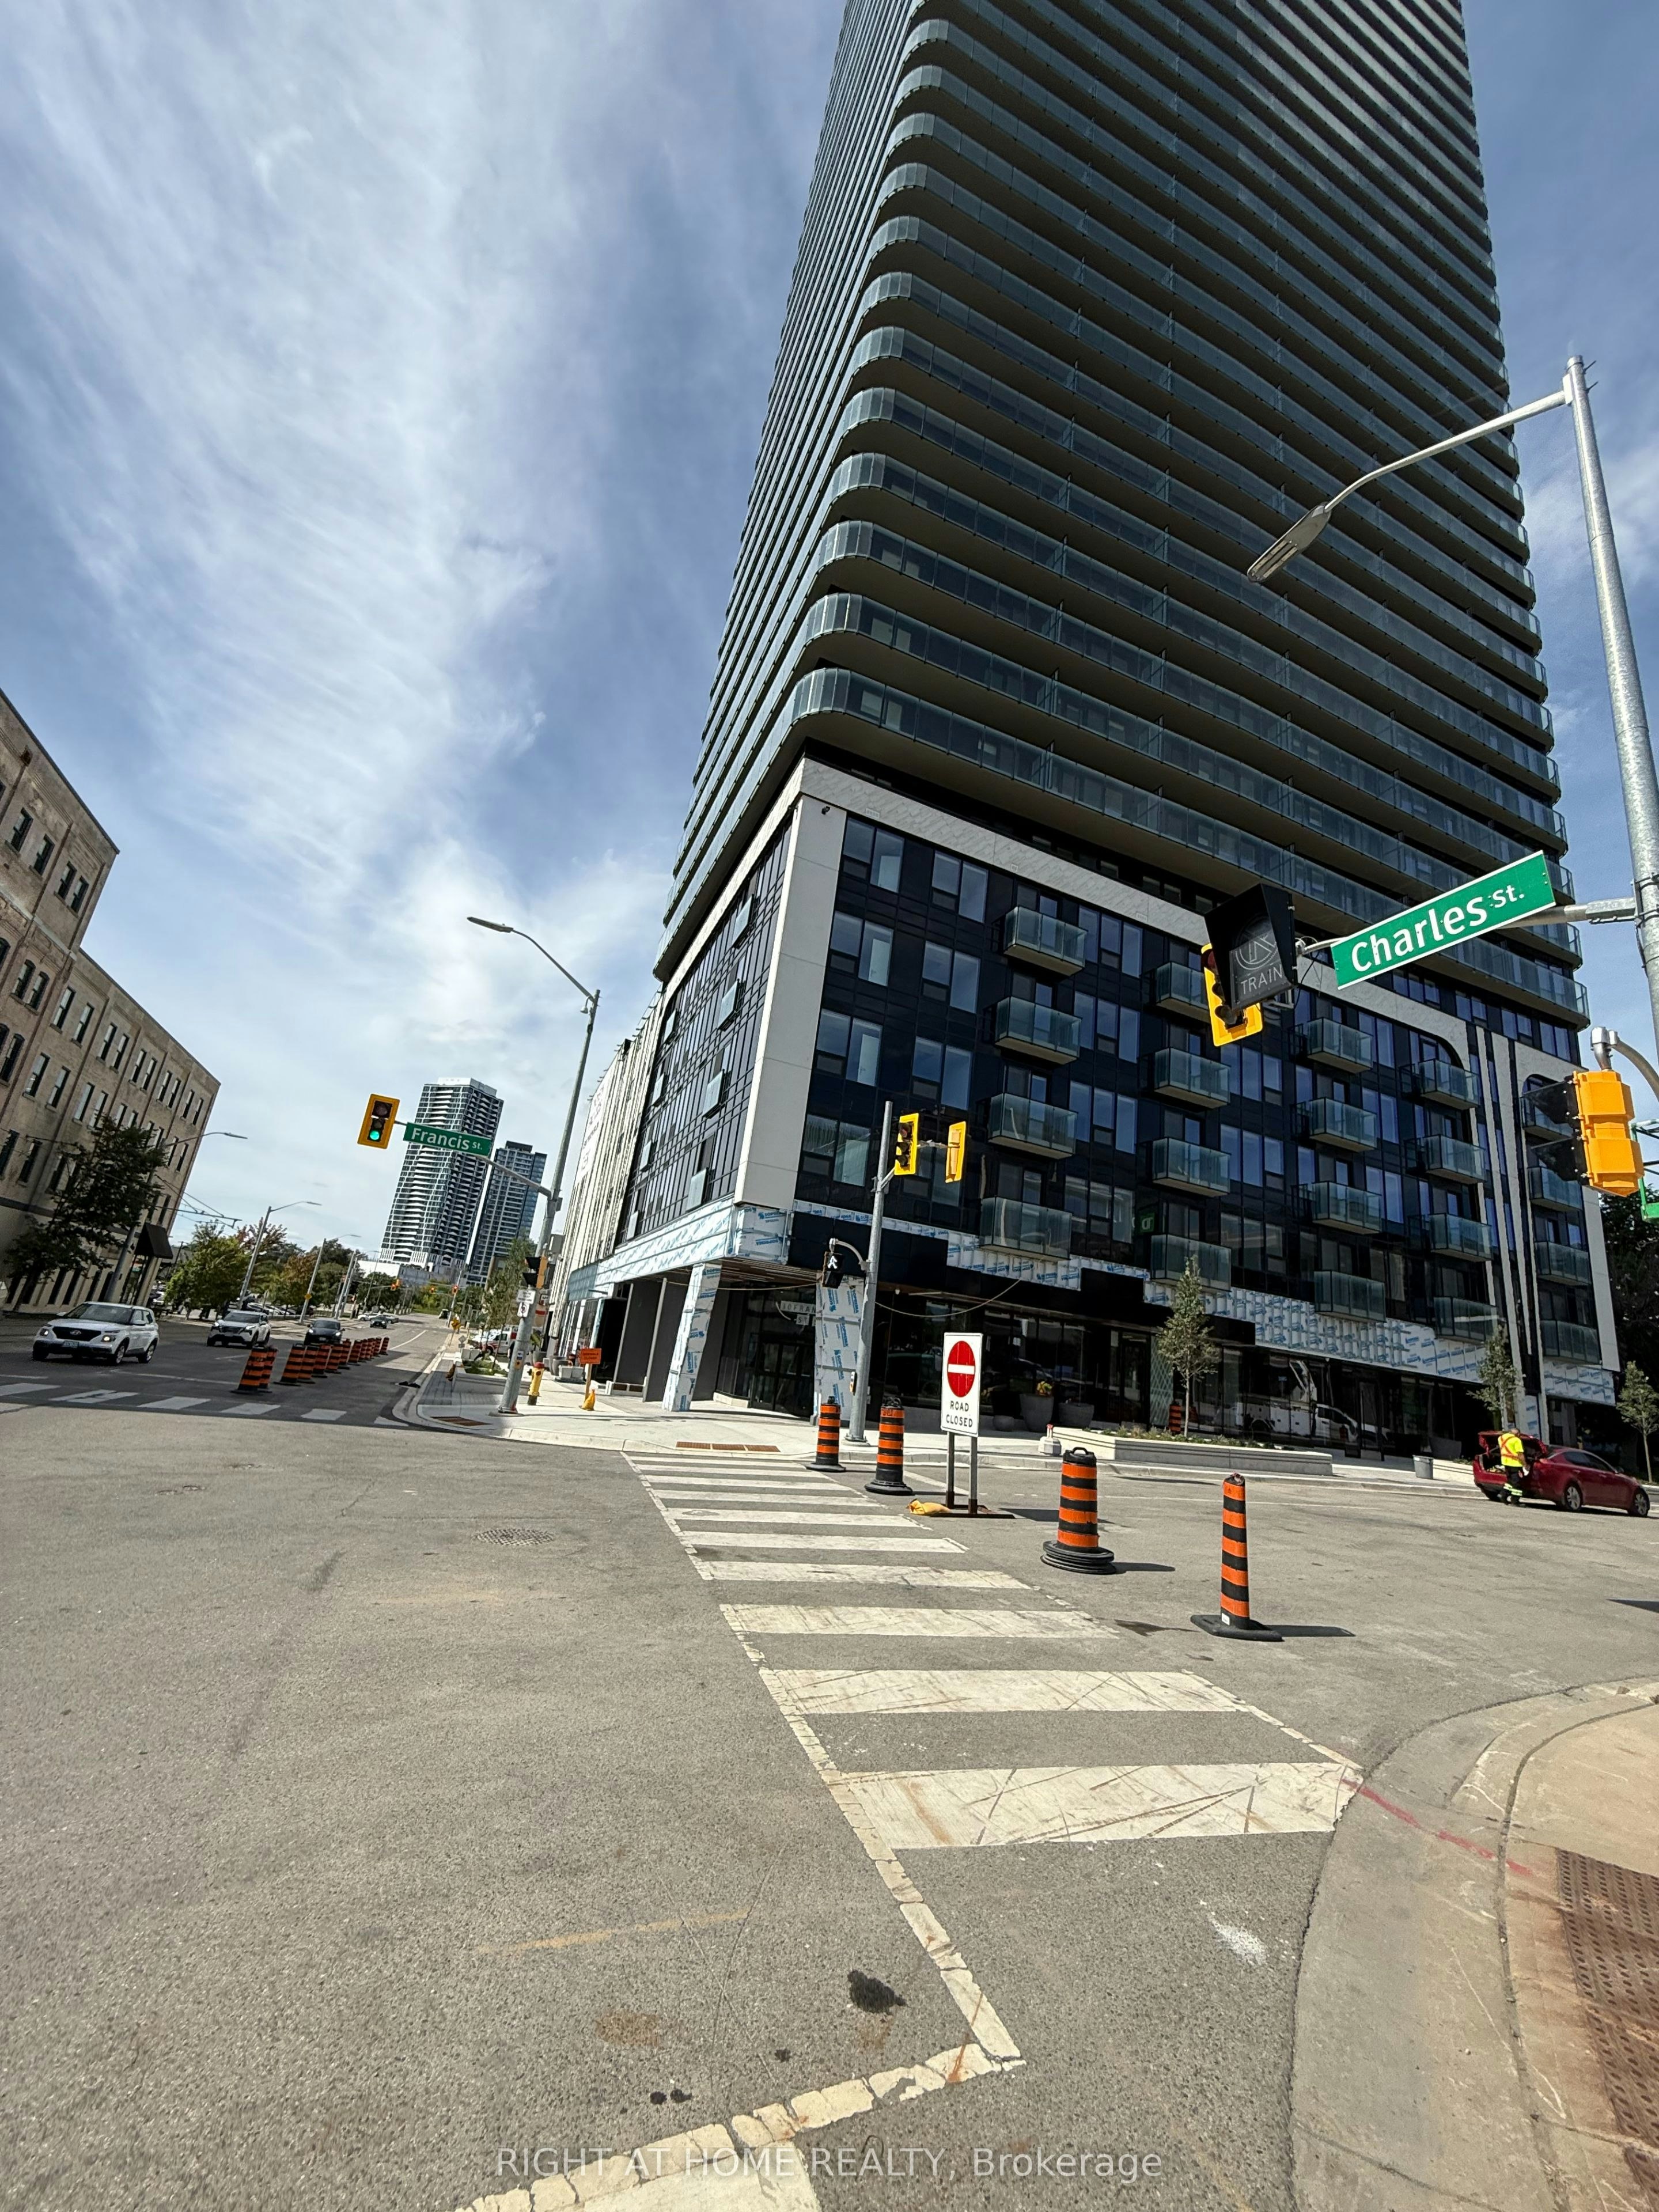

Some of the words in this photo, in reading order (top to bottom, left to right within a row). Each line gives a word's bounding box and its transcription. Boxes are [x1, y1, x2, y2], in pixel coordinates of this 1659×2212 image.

[1351, 896, 1488, 972] Charles
[1240, 964, 1283, 995] TRAIN
[411, 1127, 470, 1150] Francis
[950, 1400, 969, 1412] ROAD
[946, 1414, 973, 1427] CLOSED
